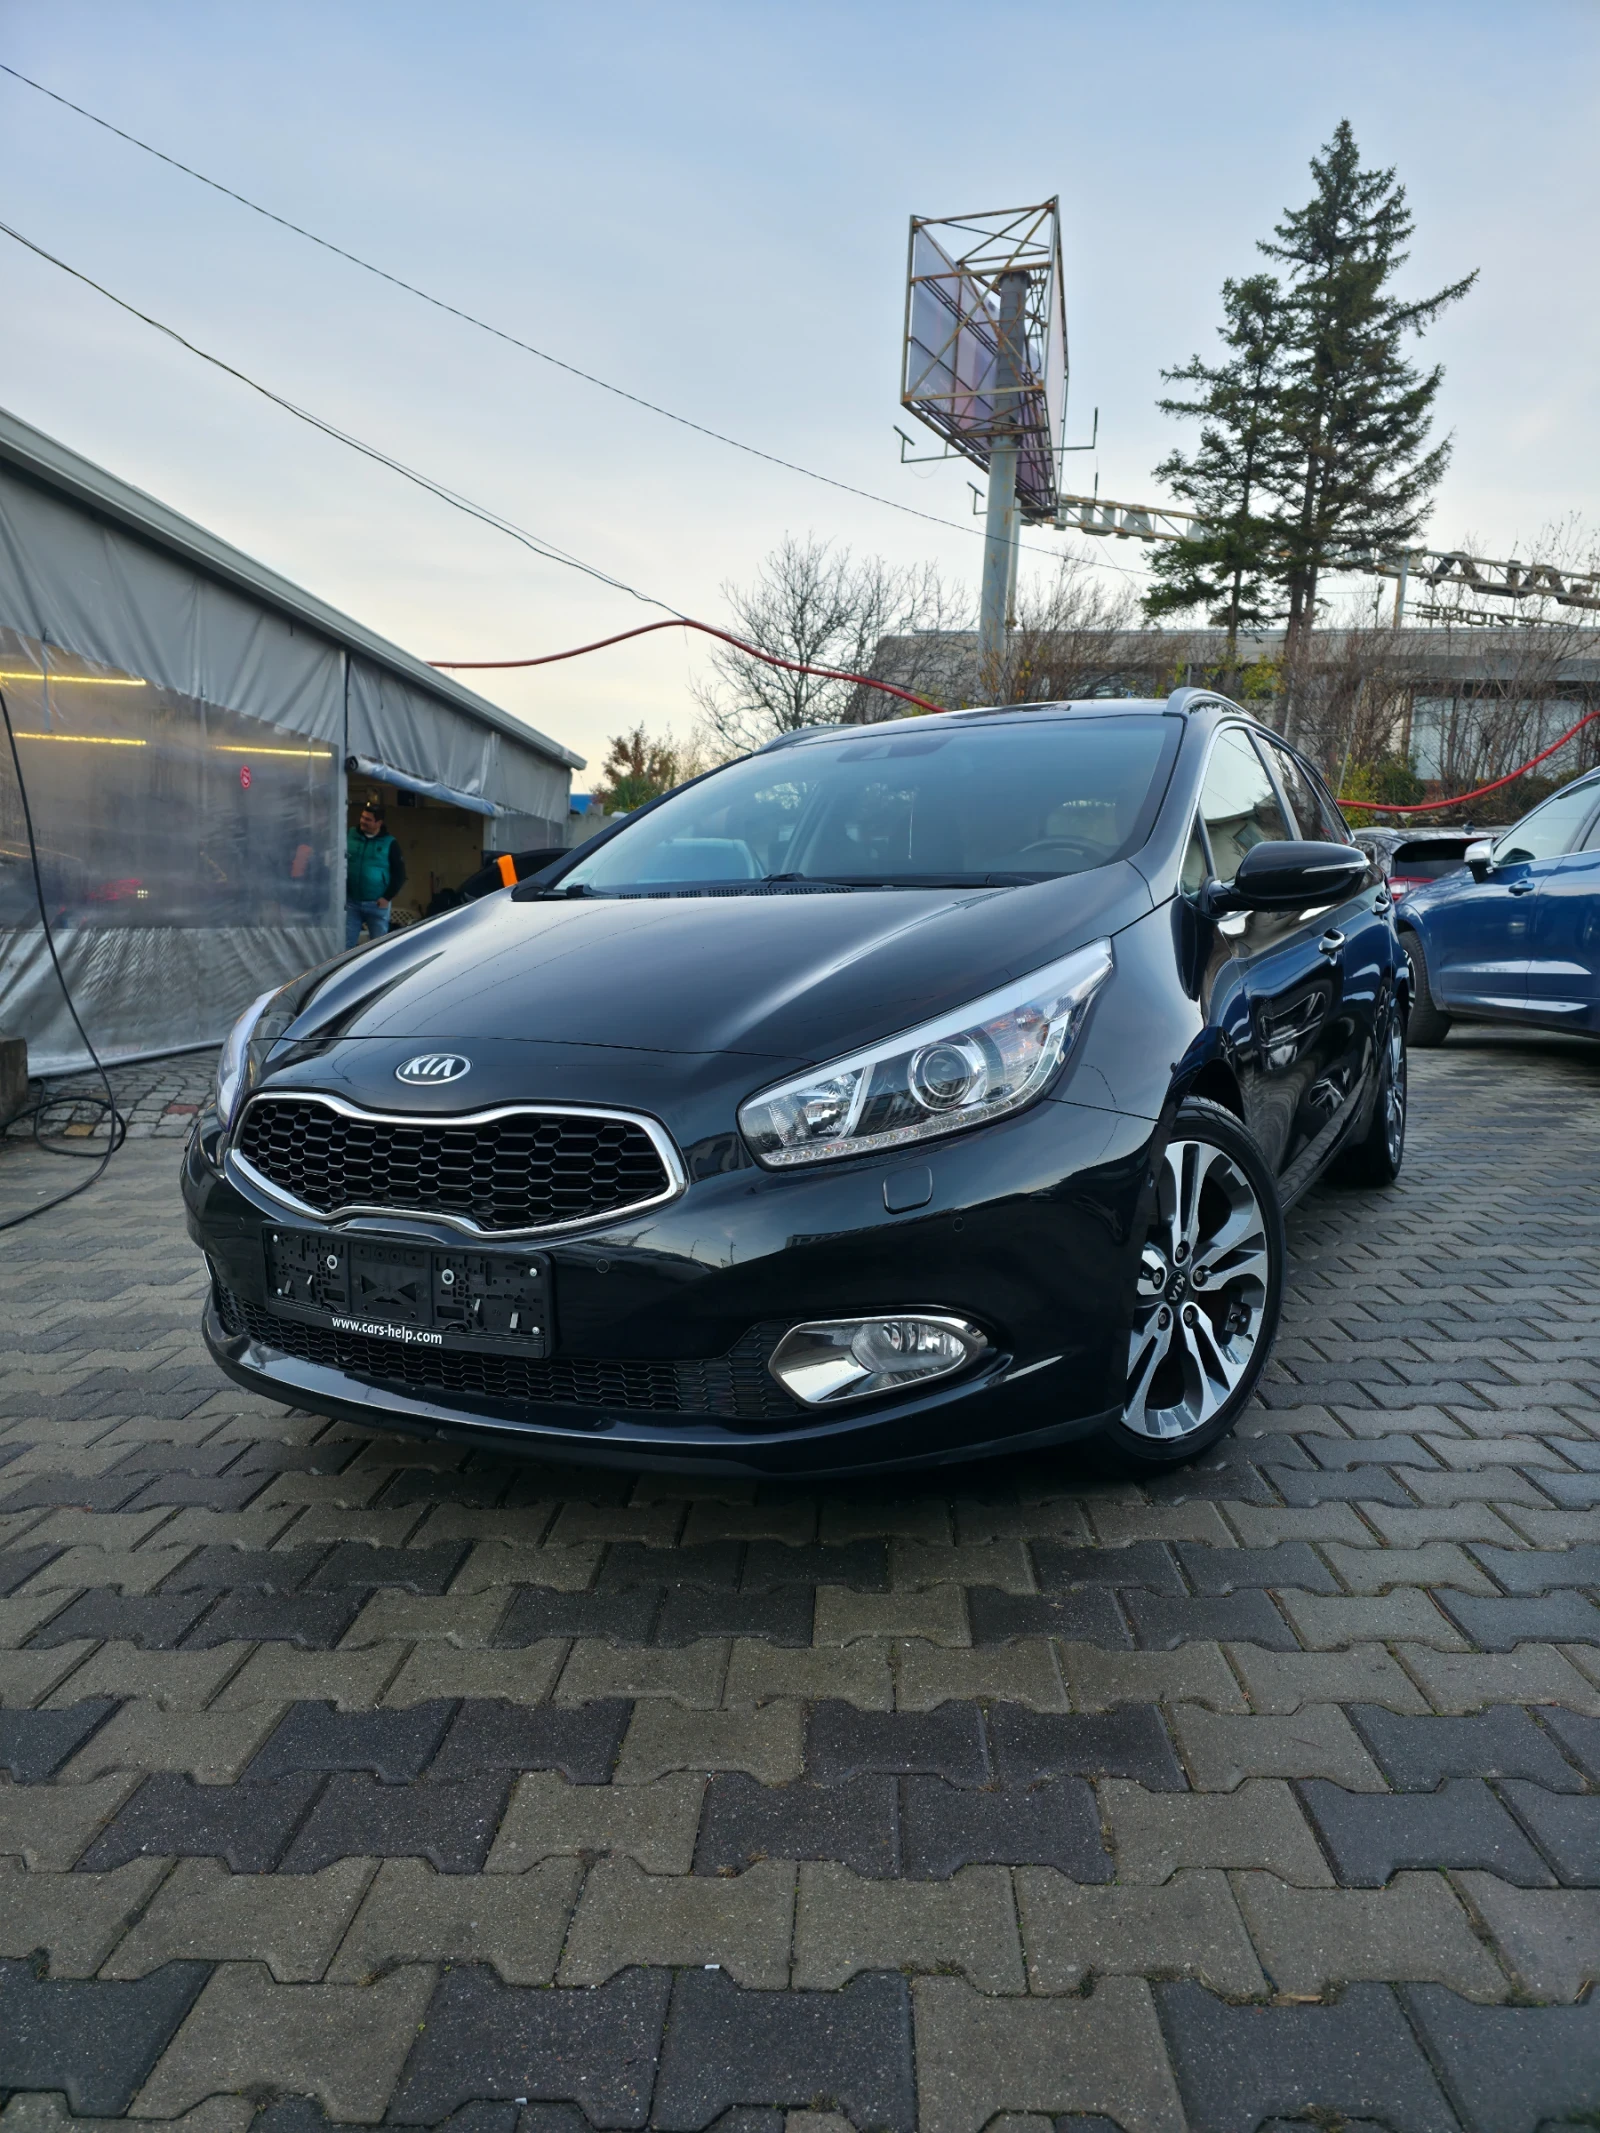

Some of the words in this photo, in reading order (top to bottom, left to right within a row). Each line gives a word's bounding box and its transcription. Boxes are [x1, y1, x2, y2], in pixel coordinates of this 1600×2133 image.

[403, 1057, 456, 1077] KIA
[1168, 1274, 1186, 1301] KIA
[331, 1317, 443, 1345] www.cars-help.com
